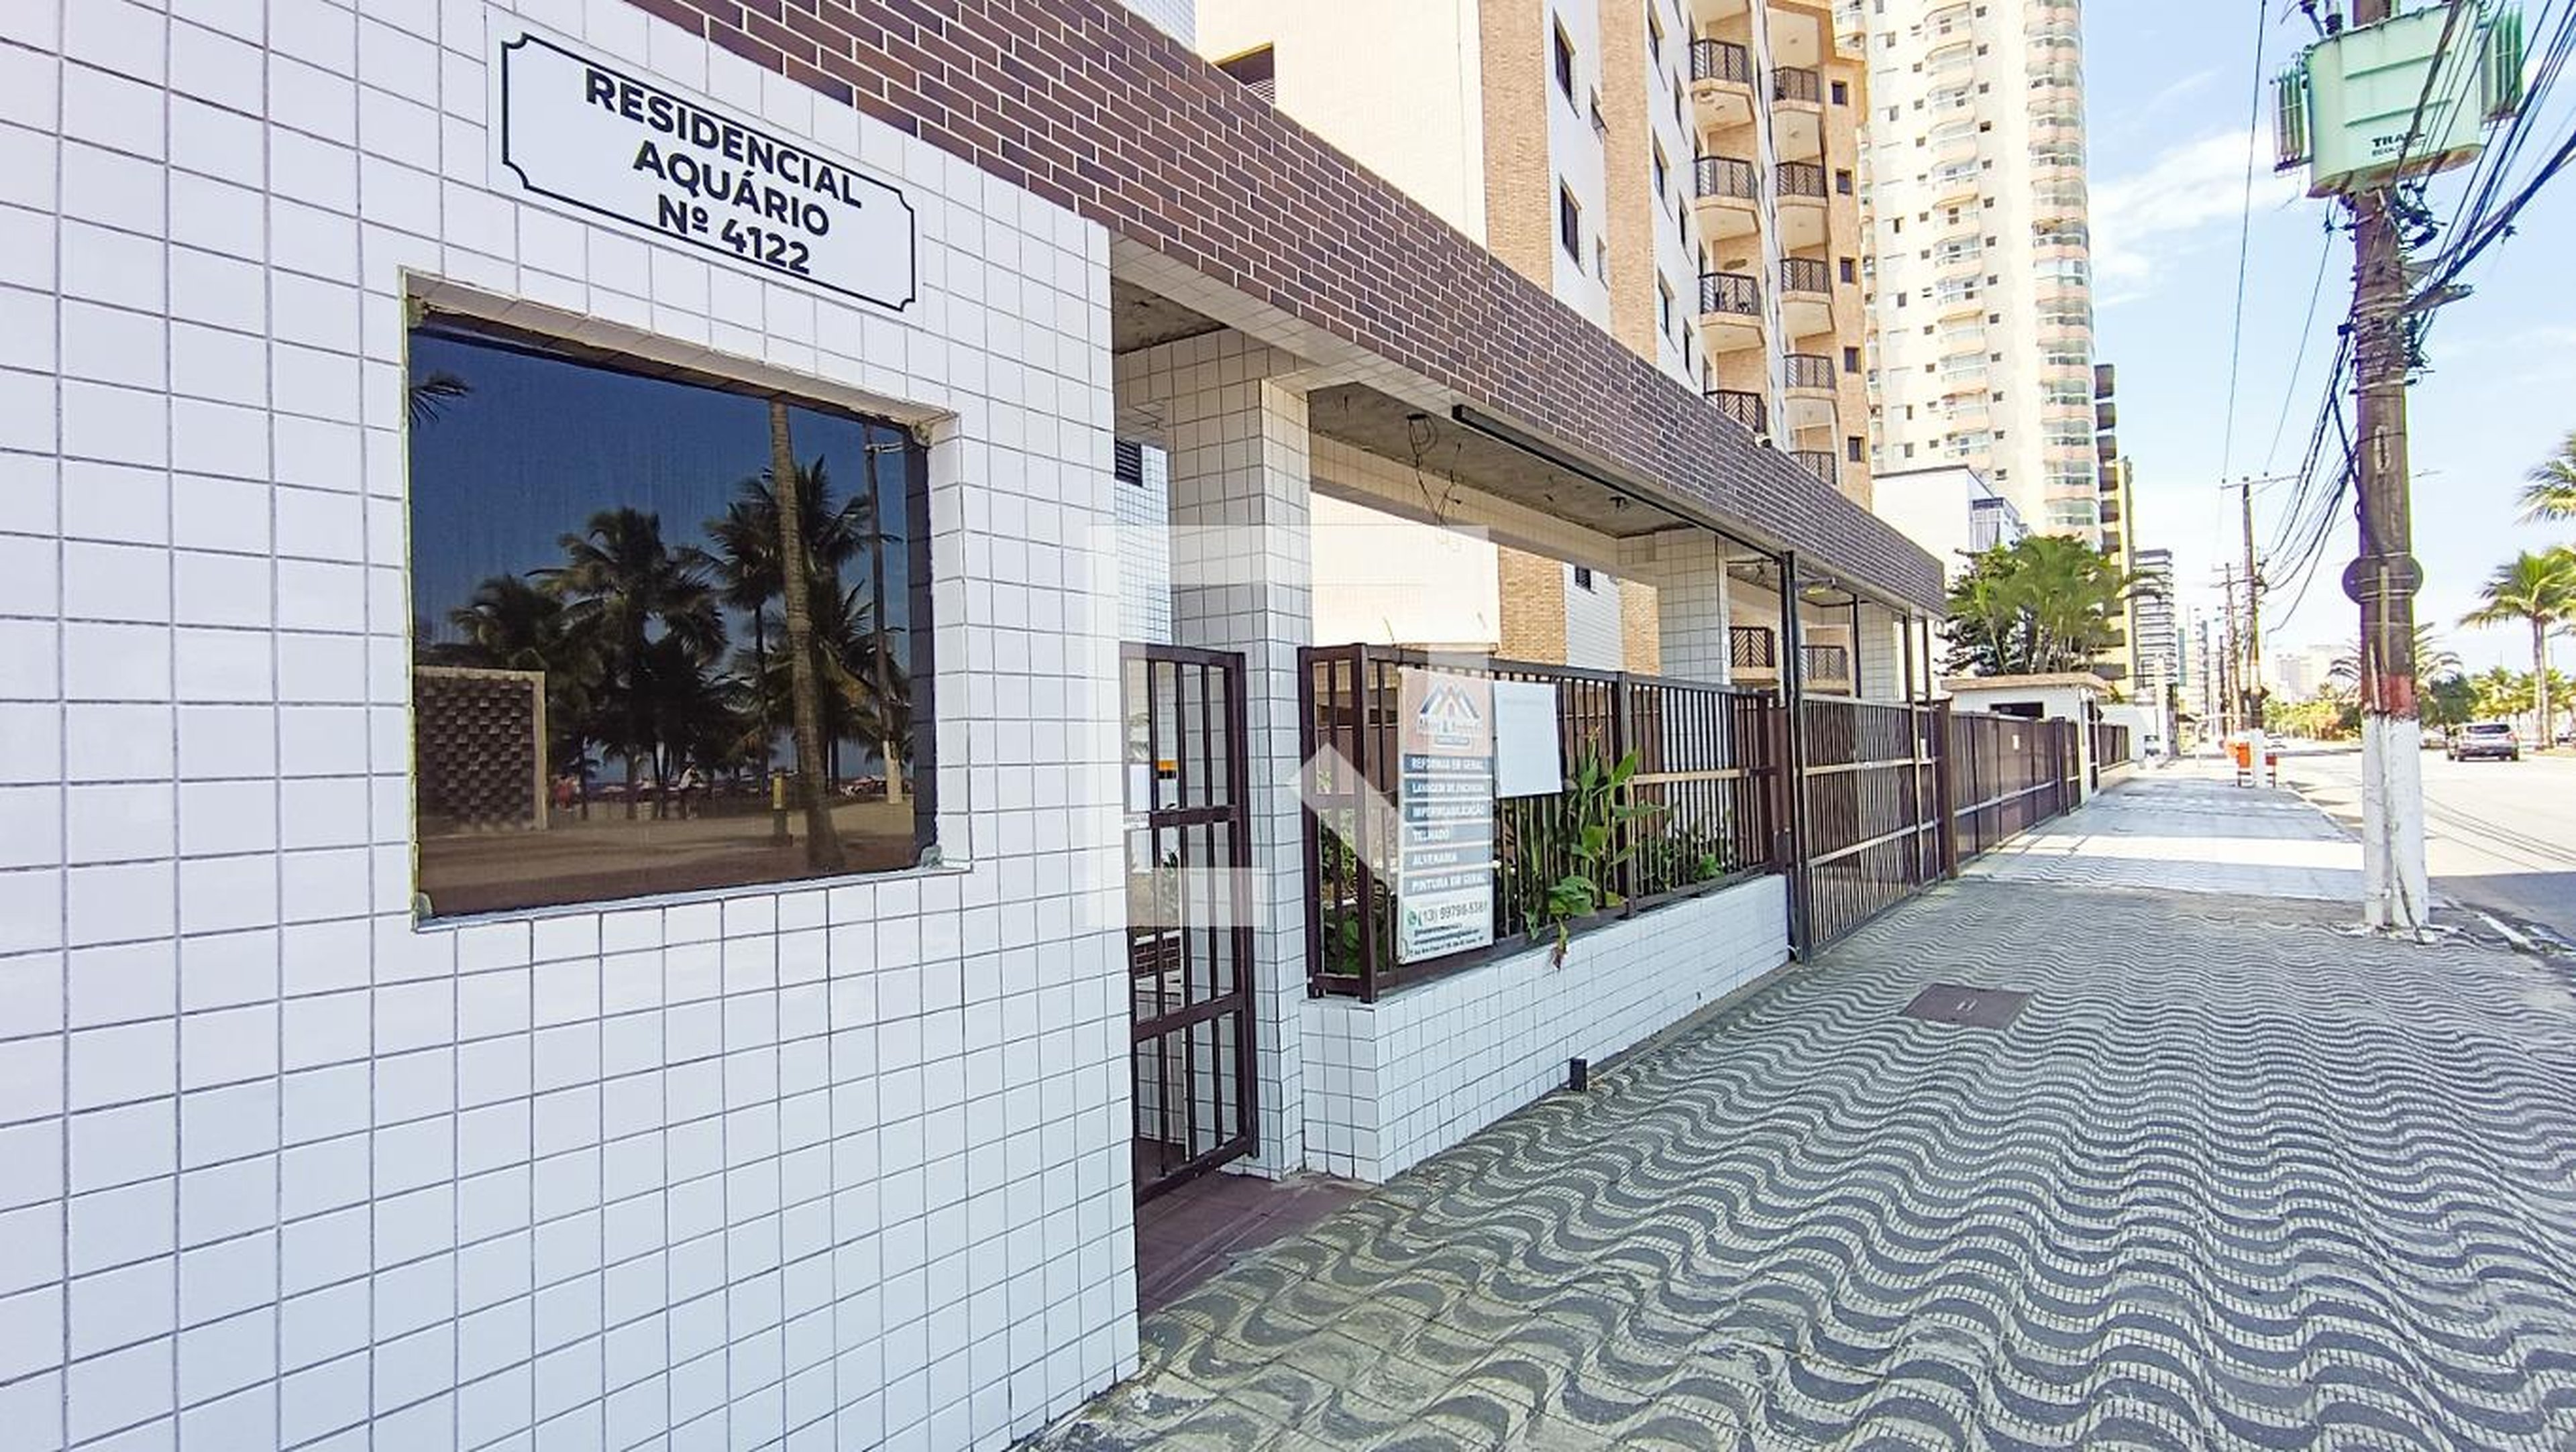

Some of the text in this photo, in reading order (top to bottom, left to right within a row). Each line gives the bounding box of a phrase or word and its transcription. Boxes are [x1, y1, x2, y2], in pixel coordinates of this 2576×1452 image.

[586, 68, 862, 209] RESIDENCIAL
[633, 140, 830, 237] AQUÁRIO
[658, 194, 810, 274] Nº 4122
[1412, 852, 1458, 866] ALVENARIA
[1413, 828, 1450, 841] TELHADO
[1412, 873, 1487, 893] PINTURA EM GERAL
